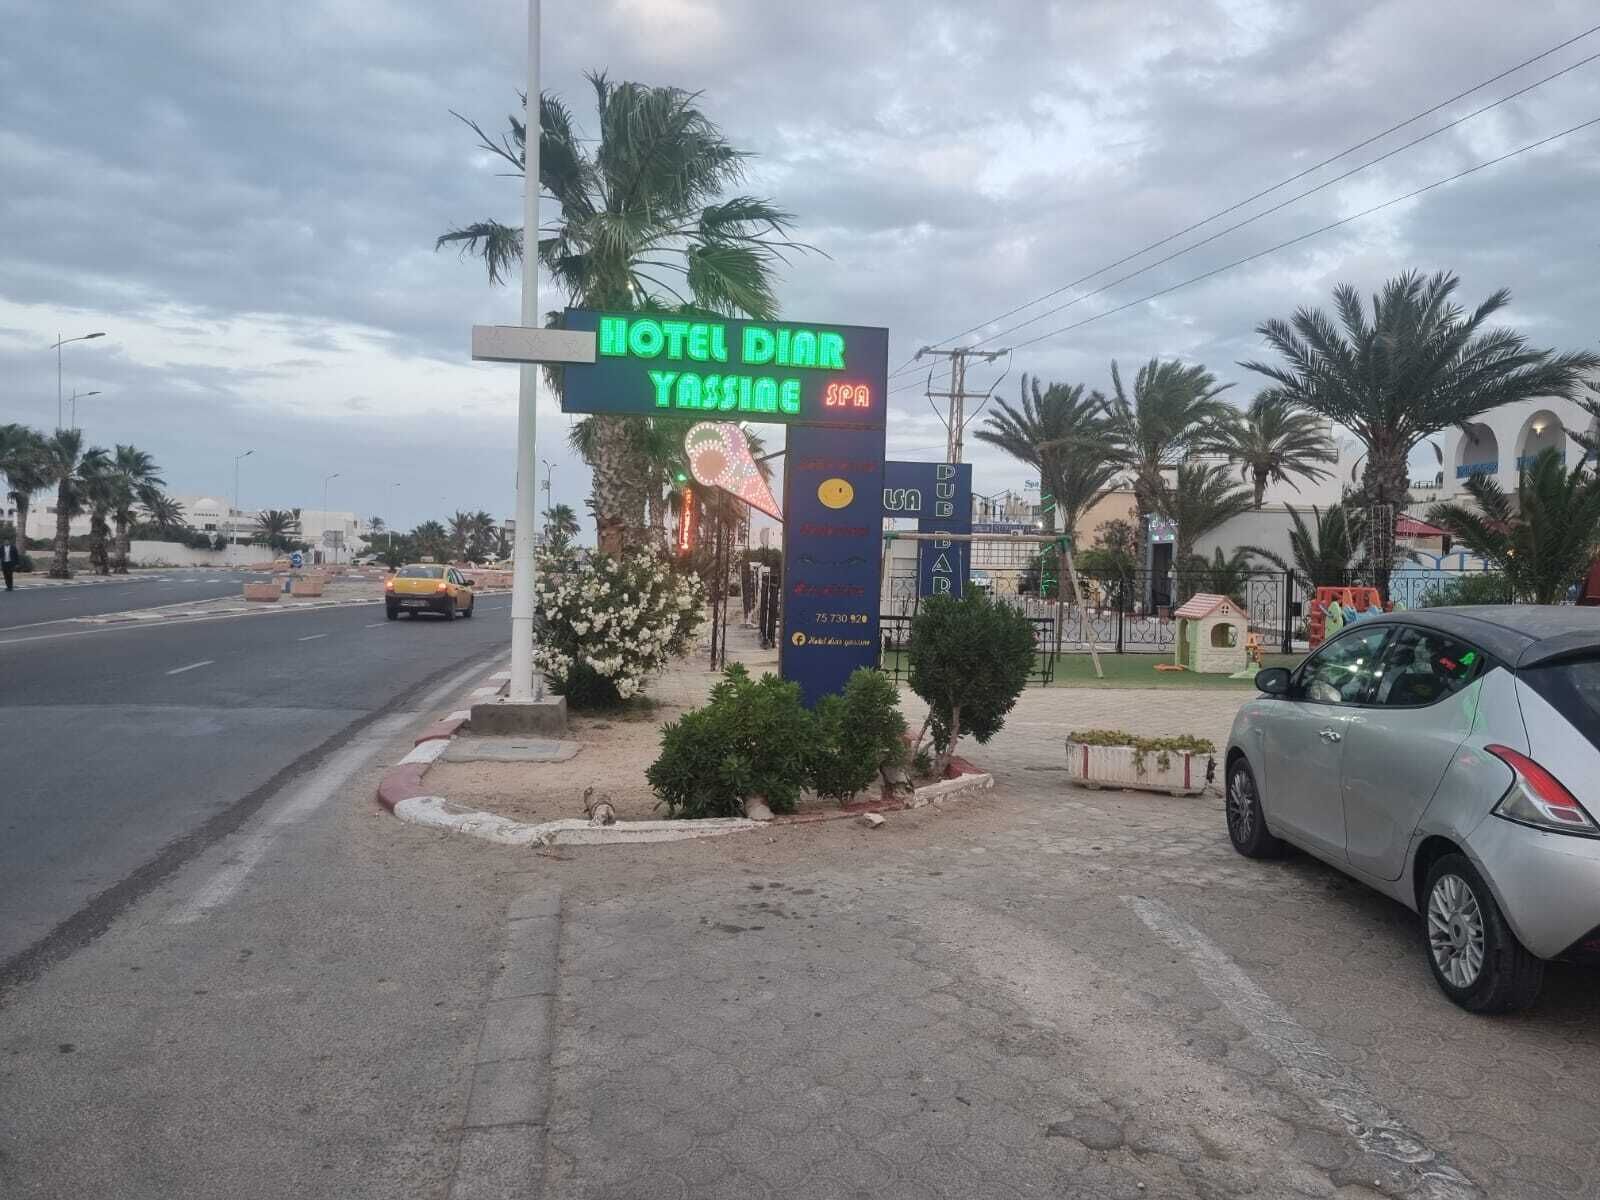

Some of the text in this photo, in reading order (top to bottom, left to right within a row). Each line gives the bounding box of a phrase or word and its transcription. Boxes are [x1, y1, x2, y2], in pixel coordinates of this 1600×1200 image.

[600, 317, 846, 369] HOTEL DIAR
[648, 370, 801, 414] YASSINE
[826, 383, 870, 408] SPA
[935, 464, 956, 517] PUB
[815, 613, 828, 624] 75
[831, 613, 848, 624] 730
